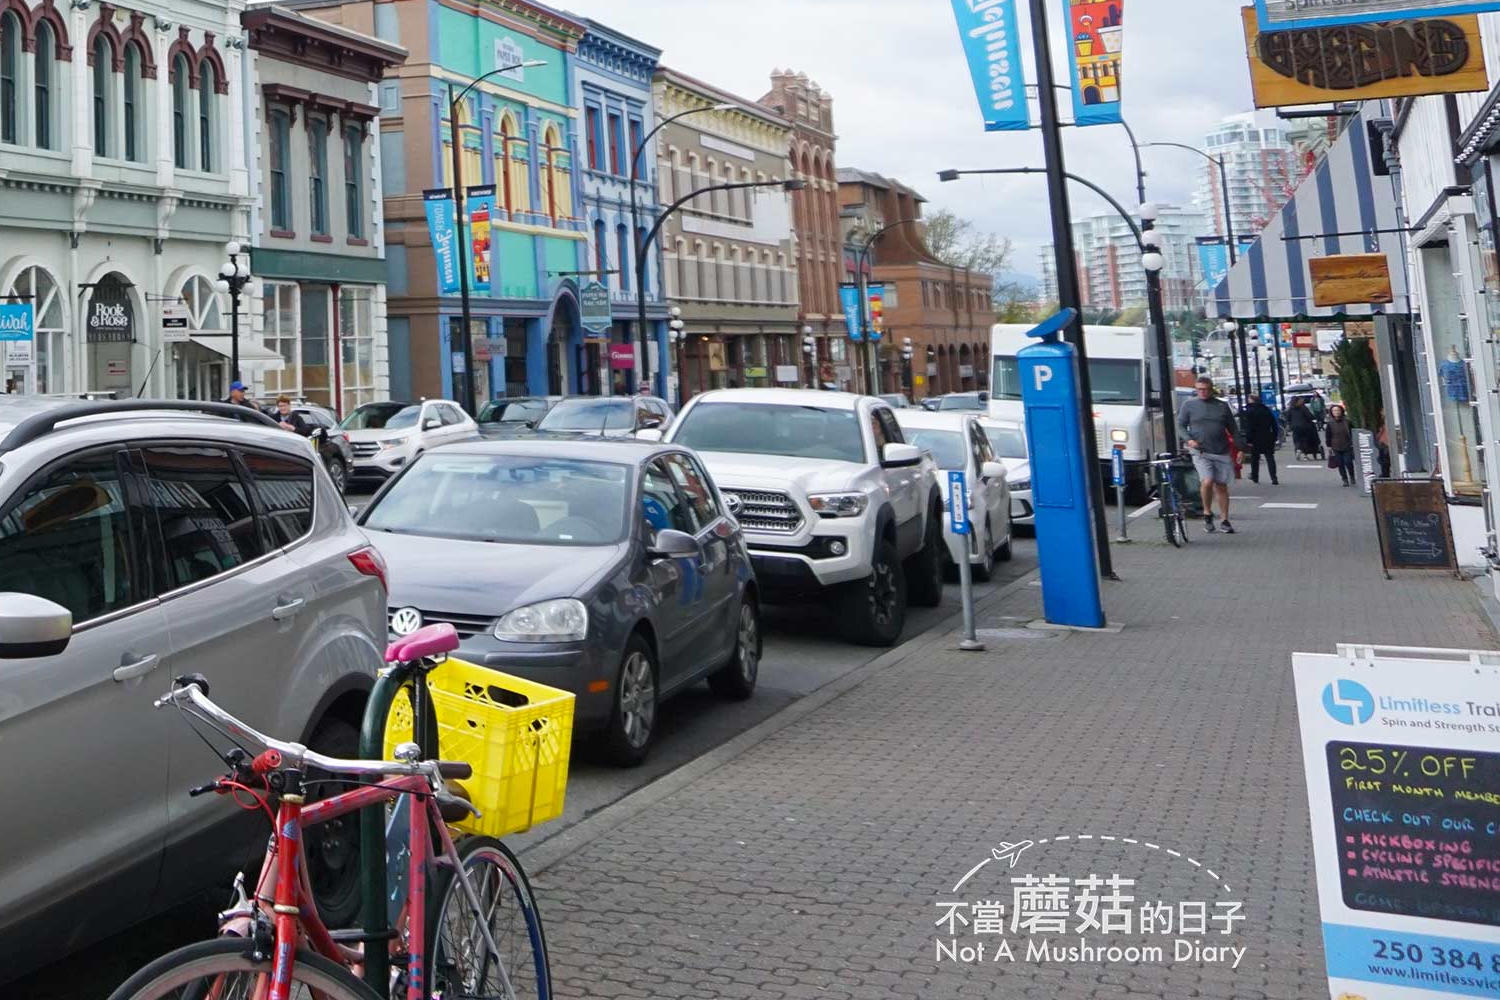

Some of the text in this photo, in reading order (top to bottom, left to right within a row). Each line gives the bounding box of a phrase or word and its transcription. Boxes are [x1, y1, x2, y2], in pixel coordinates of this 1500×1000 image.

[95, 303, 125, 317] Rook
[90, 314, 128, 327] & Rose
[1033, 364, 1053, 391] P
[1379, 695, 1461, 715] Limitless
[1381, 717, 1407, 730] Spin
[1409, 719, 1431, 729] and
[1434, 720, 1486, 733] Strength
[1339, 747, 1476, 780] 25% OFF
[1345, 777, 1382, 792] FIRST
[1392, 783, 1445, 798] MONTH
[1343, 807, 1393, 824] CHECK
[1402, 813, 1432, 827] OUT
[1442, 817, 1475, 831] OUR
[1361, 833, 1472, 854] KICKBOXING
[1361, 849, 1424, 866] CYCLING
[1361, 866, 1430, 884] ATHLETIC
[1372, 938, 1423, 964] 250
[1430, 946, 1484, 972] 384
